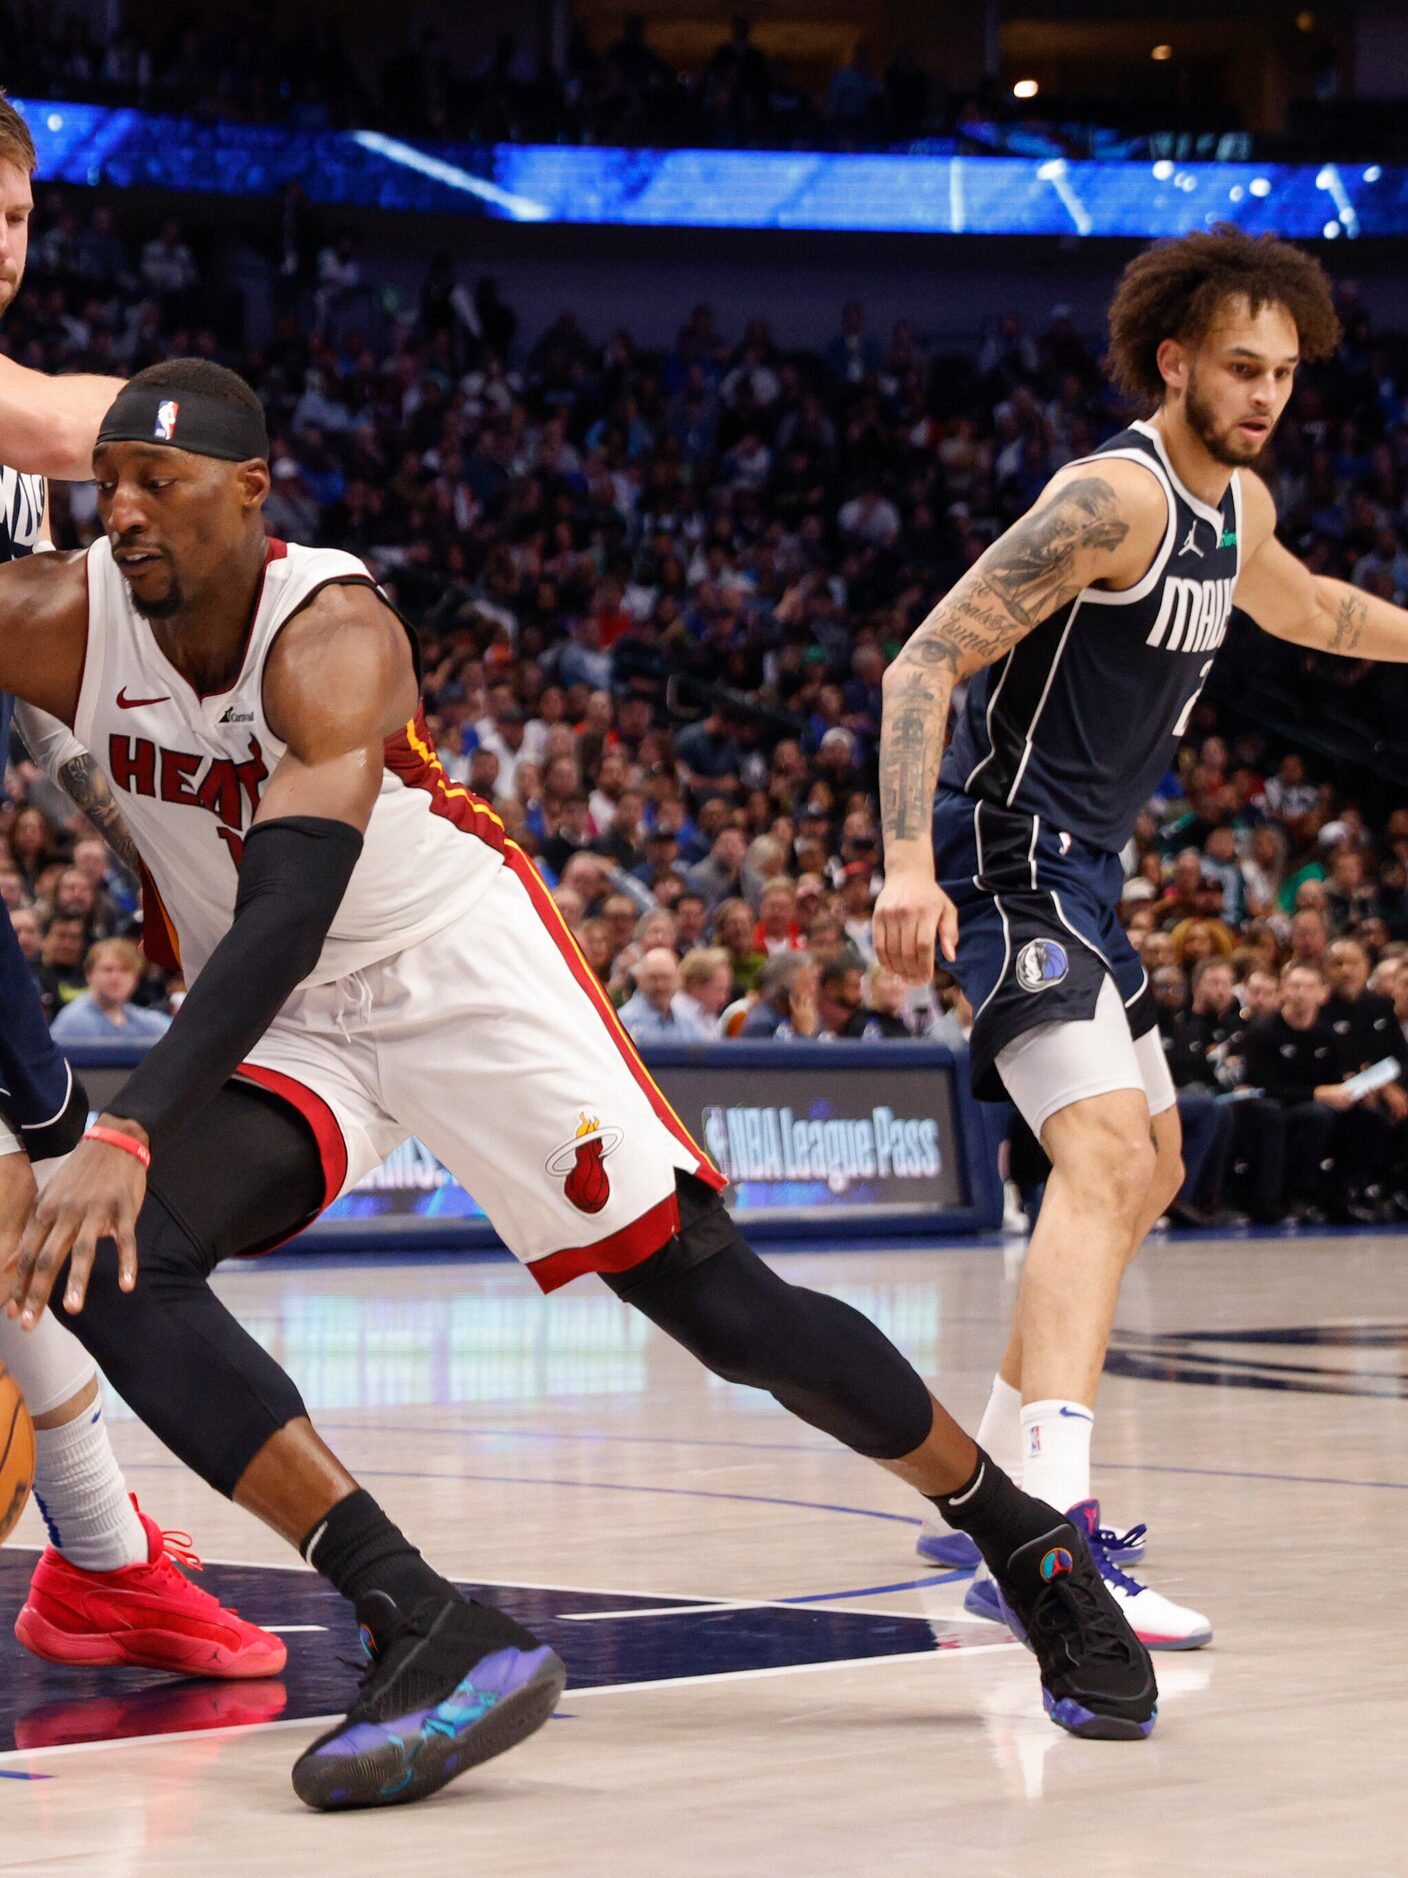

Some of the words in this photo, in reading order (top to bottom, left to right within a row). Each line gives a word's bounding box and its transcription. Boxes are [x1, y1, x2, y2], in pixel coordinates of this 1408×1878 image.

[109, 732, 269, 832] HEAT
[726, 1107, 783, 1181] NBA
[779, 1106, 877, 1193] League
[872, 1106, 941, 1179] Pass
